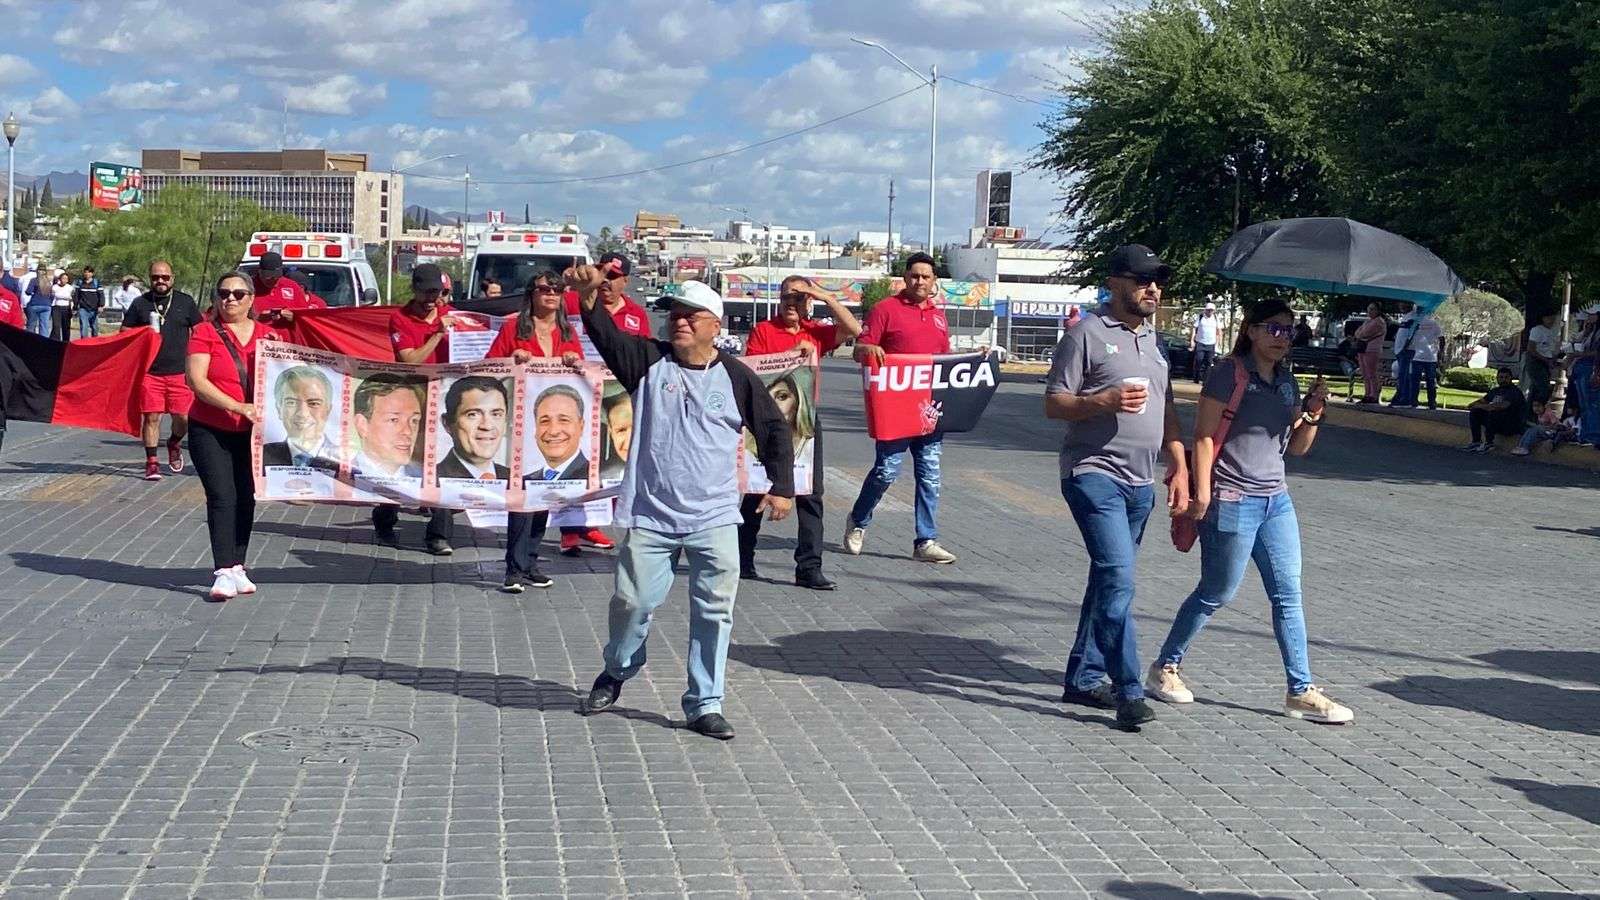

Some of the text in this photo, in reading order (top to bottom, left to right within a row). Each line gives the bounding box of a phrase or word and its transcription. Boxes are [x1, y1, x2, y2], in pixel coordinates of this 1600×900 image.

[260, 352, 292, 361] ZOZAYA
[264, 345, 298, 356] CARLOS
[864, 361, 995, 392] HUELGA
[429, 384, 439, 433] ATRONO
